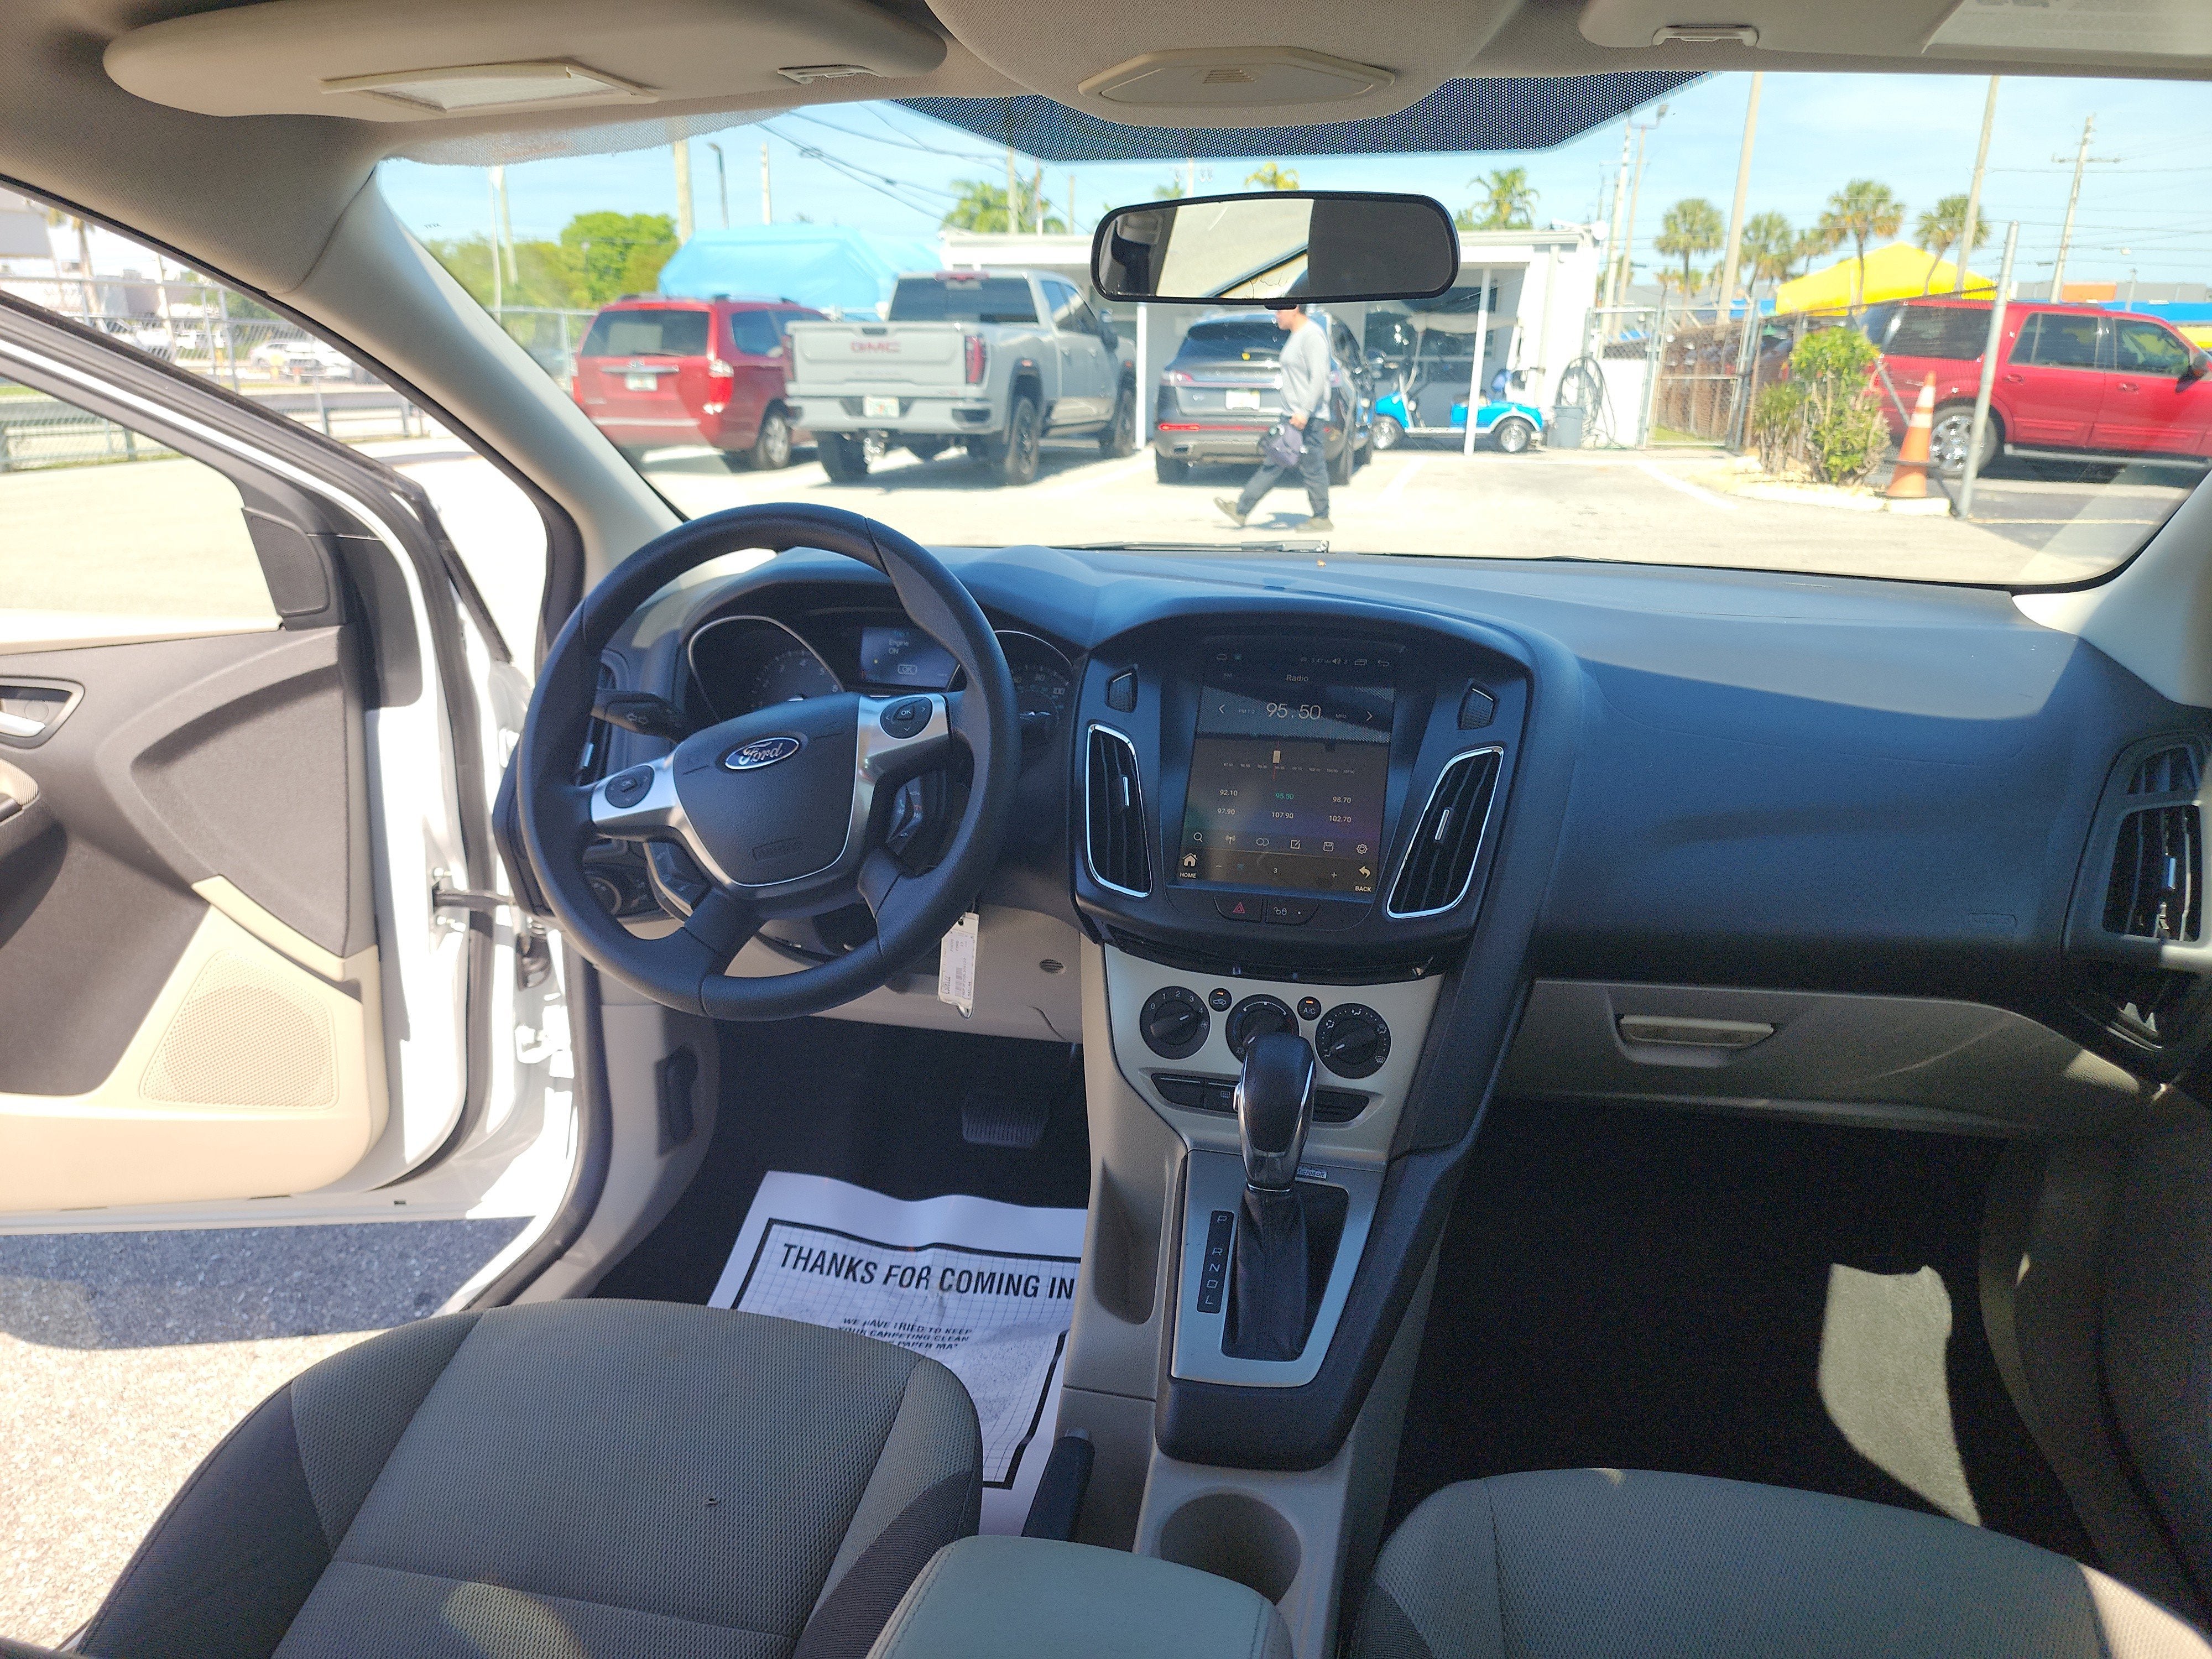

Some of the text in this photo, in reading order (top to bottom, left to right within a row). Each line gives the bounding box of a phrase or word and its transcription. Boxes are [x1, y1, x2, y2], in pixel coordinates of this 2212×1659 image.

[852, 341, 900, 353] GMC
[1286, 674, 1309, 682] Radio
[738, 741, 783, 765] Ford
[1329, 815, 1352, 823] 102.70
[1217, 1215, 1228, 1223] P
[1212, 1248, 1223, 1256] R
[780, 1243, 1076, 1300] THANKS FOR COMING IN
[1209, 1263, 1220, 1272] N
[1206, 1280, 1218, 1288] D
[1204, 1295, 1213, 1305] L
[863, 1318, 890, 1328] HAVE
[894, 1322, 925, 1333] TRIED
[870, 1329, 931, 1341] CARPETING
